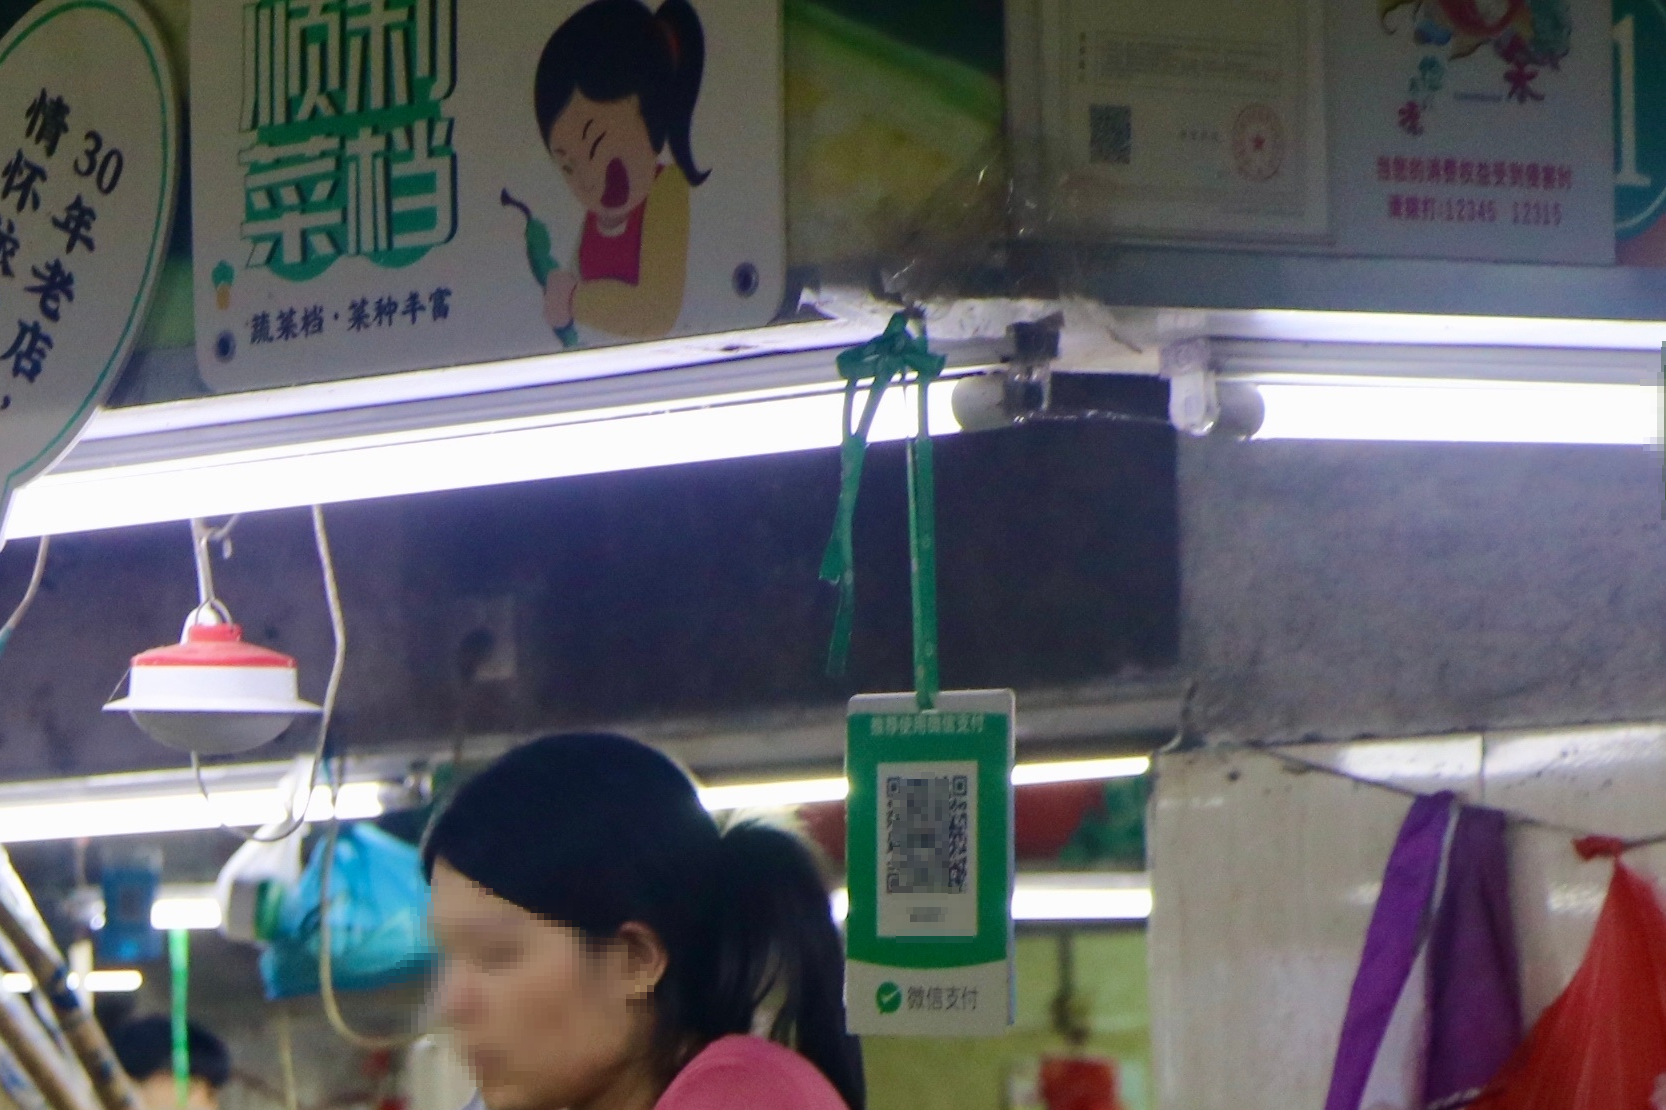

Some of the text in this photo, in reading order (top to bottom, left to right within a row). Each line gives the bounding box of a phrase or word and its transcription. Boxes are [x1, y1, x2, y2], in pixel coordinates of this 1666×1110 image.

[239, 0, 457, 133] 顺利
[239, 117, 458, 270] 菜档
[1512, 200, 1563, 226] 12315
[907, 985, 979, 1010] 微信支付
